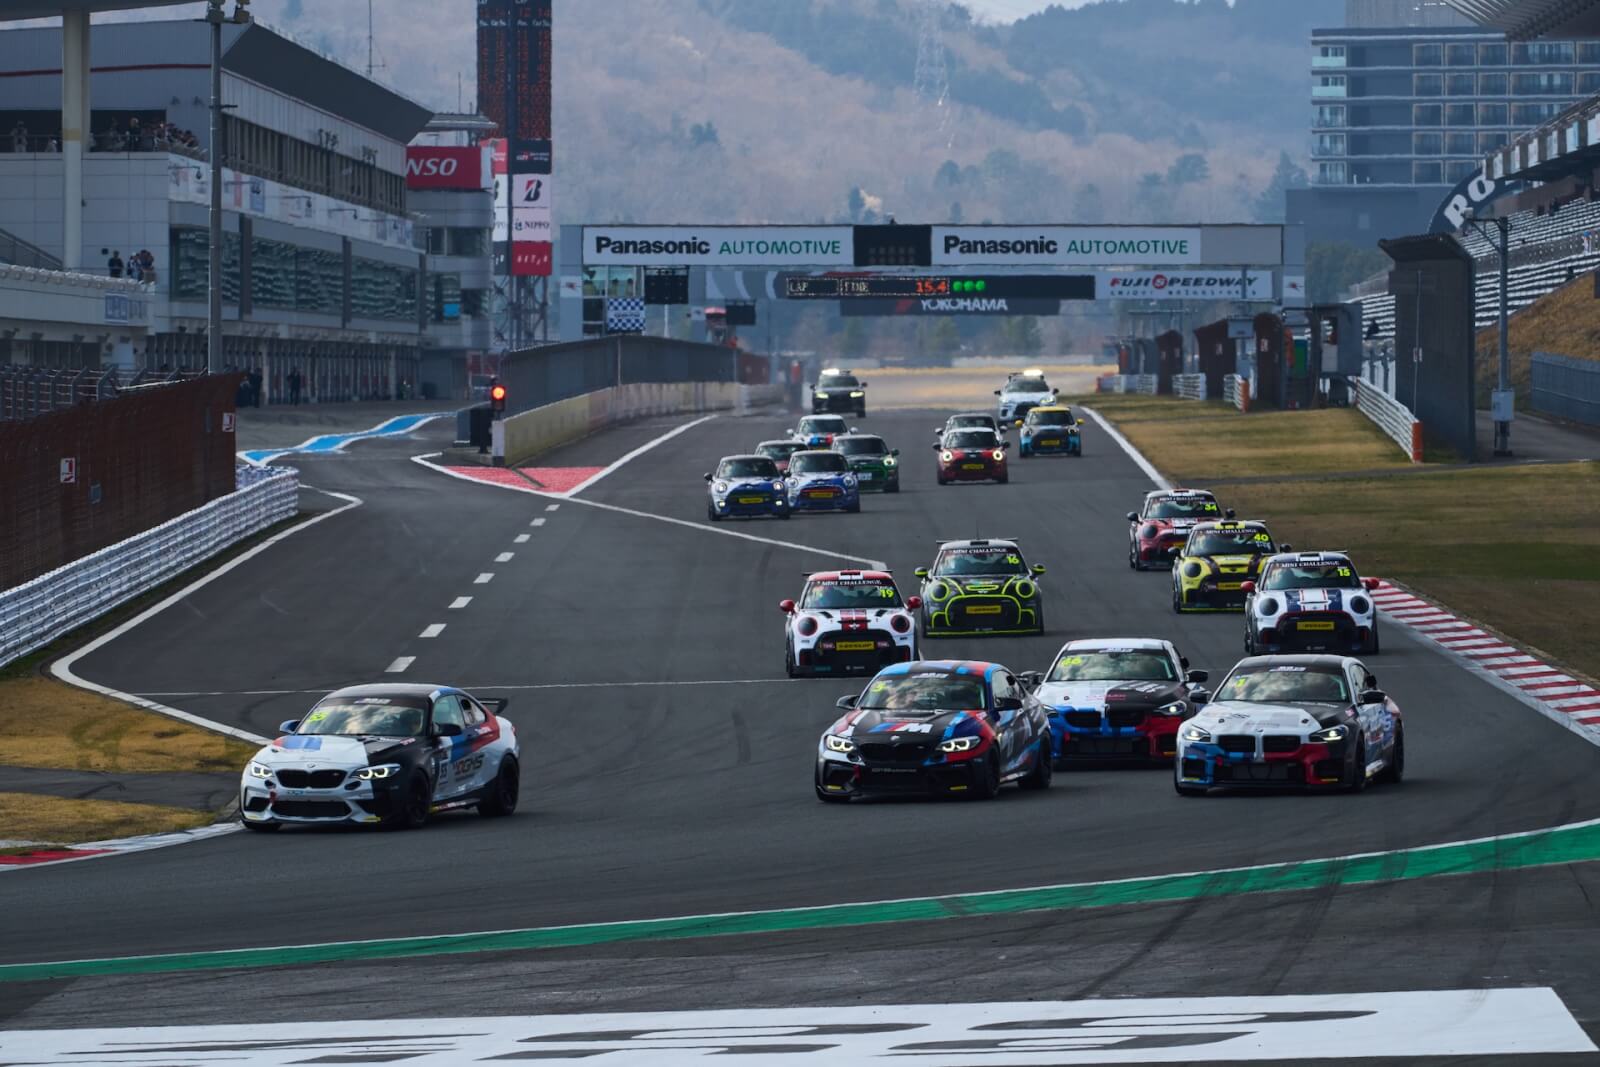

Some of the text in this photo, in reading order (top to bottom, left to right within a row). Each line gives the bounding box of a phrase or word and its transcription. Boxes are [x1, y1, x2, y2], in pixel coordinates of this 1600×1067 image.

[405, 158, 457, 176] NSO
[595, 236, 841, 255] Panasonic AUTOMOTIVE
[943, 235, 1188, 255] Panasonic AUTOMOTIVE
[1110, 277, 1151, 287] FUJI
[920, 298, 1009, 312] YOKOHAMA
[1253, 533, 1269, 542] 40
[1007, 556, 1020, 565] 16
[1337, 568, 1351, 577] 15
[840, 578, 882, 586] CHALLENGE
[880, 588, 895, 598] 19
